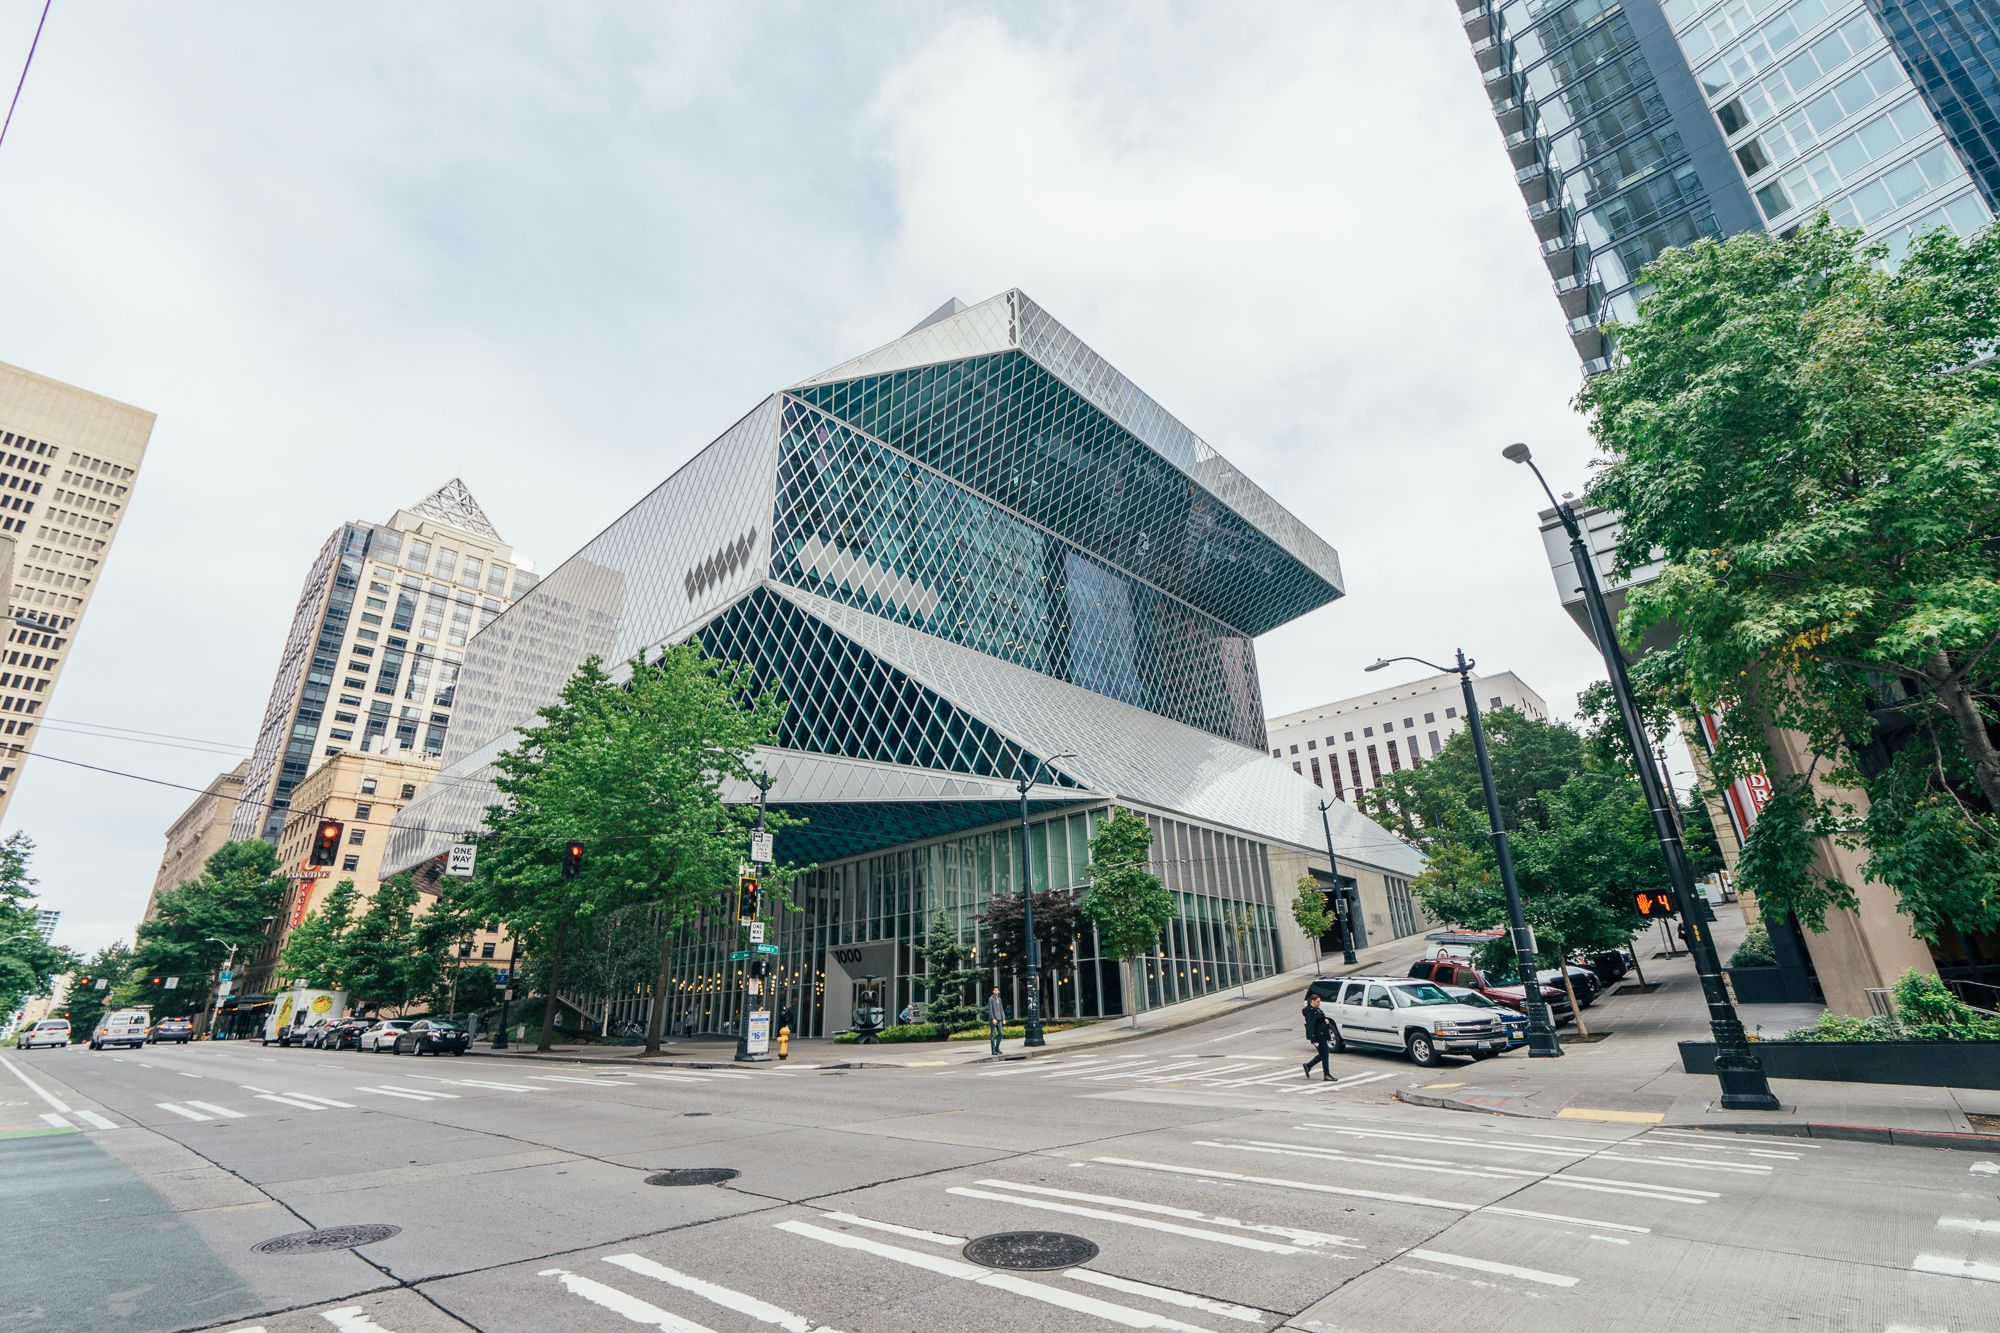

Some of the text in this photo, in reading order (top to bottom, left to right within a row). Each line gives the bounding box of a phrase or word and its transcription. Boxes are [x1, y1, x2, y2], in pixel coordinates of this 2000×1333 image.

[454, 847, 472, 855] ONE
[453, 855, 471, 863] WAY
[286, 871, 329, 879] EXECUTIVE
[293, 883, 308, 926] PACIFI
[1657, 894, 1671, 911] 4
[835, 948, 862, 964] 1000
